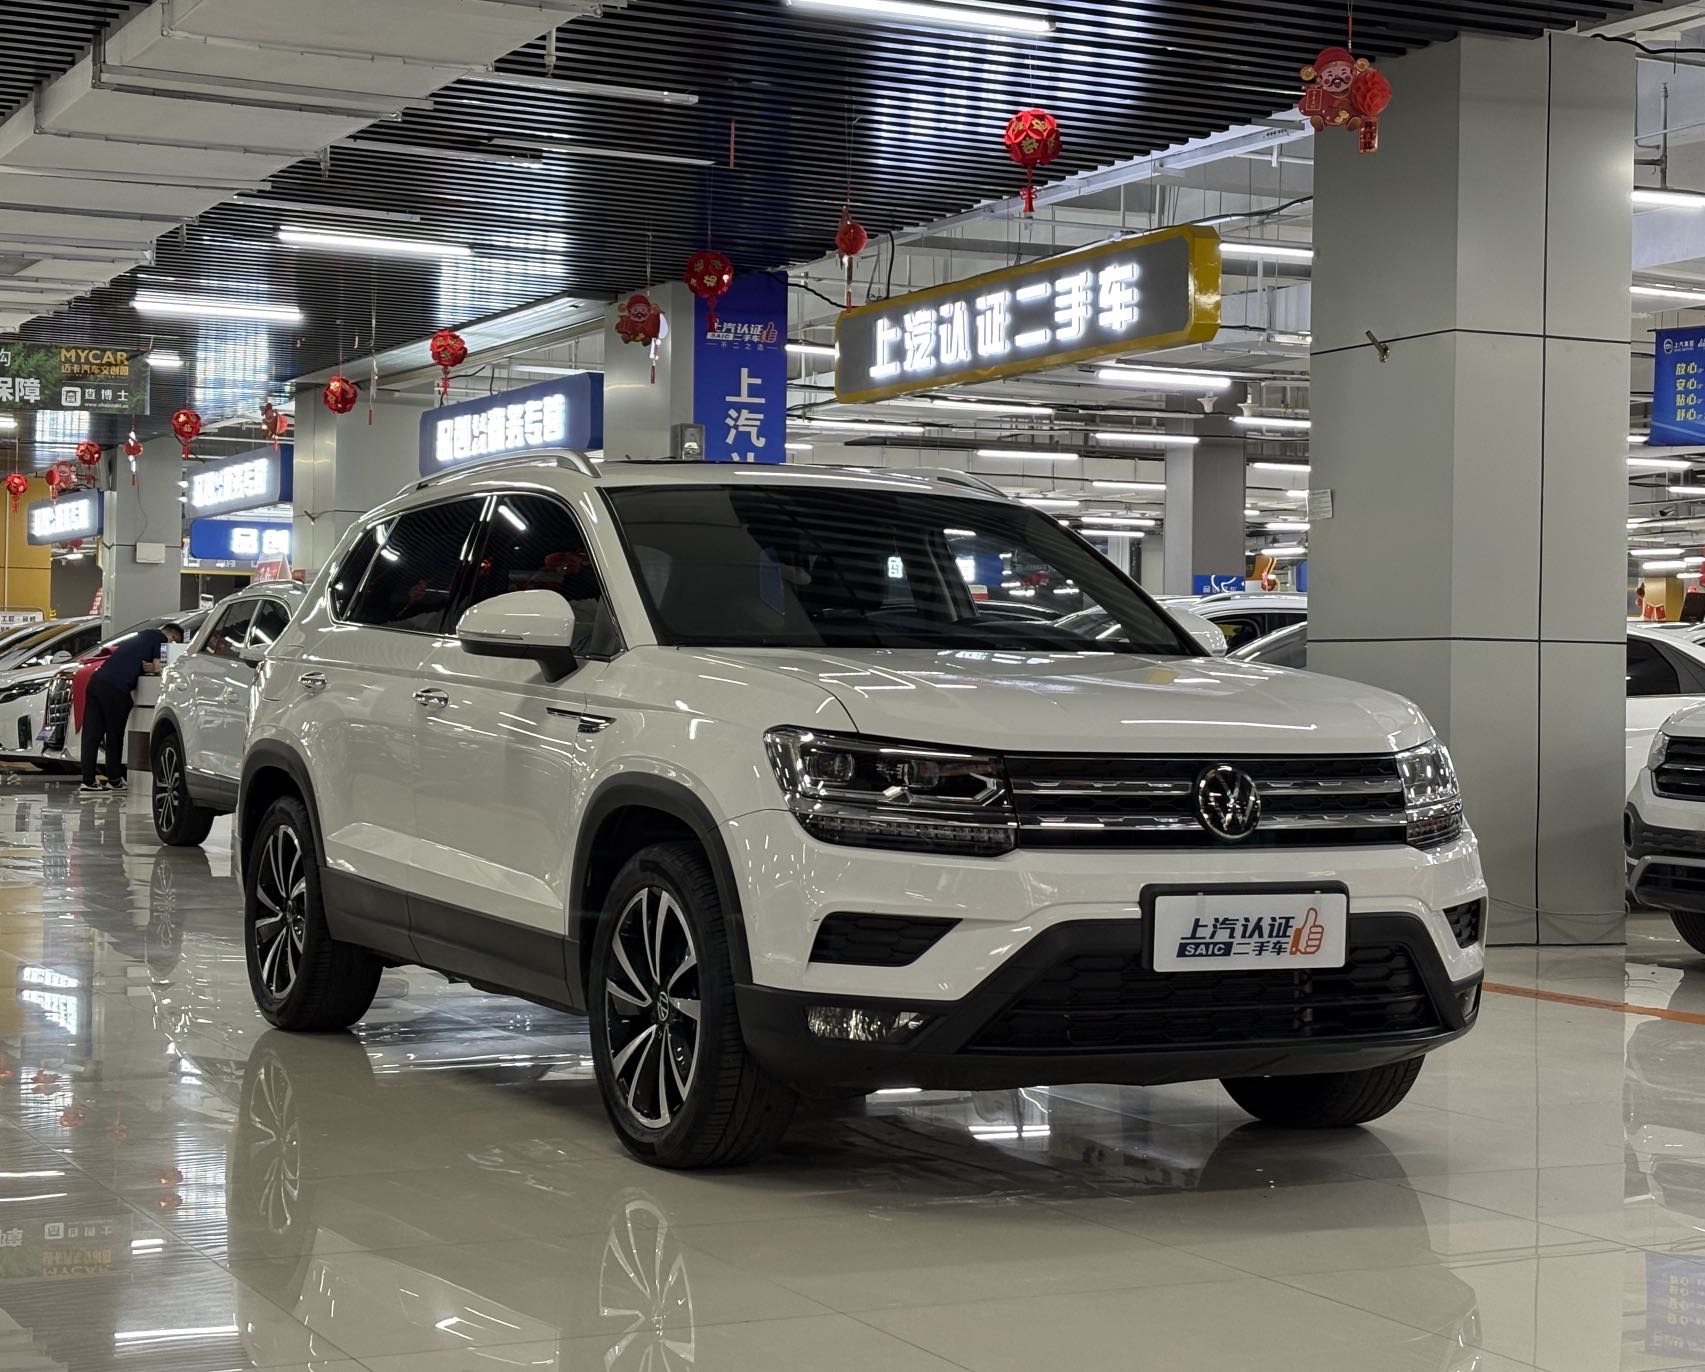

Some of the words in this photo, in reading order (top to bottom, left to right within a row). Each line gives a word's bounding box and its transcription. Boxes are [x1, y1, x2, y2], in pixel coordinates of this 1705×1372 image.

[868, 263, 1139, 378] 上汽认证二手车
[60, 348, 129, 364] MYCAR
[1675, 363, 1697, 376] 放心
[1675, 378, 1697, 391] 安心
[84, 388, 129, 401] 查博士
[724, 367, 766, 462] 上汽
[1180, 916, 1296, 940] 上汽认证
[1184, 944, 1226, 956] SAIC
[1233, 940, 1290, 956] 二手车
